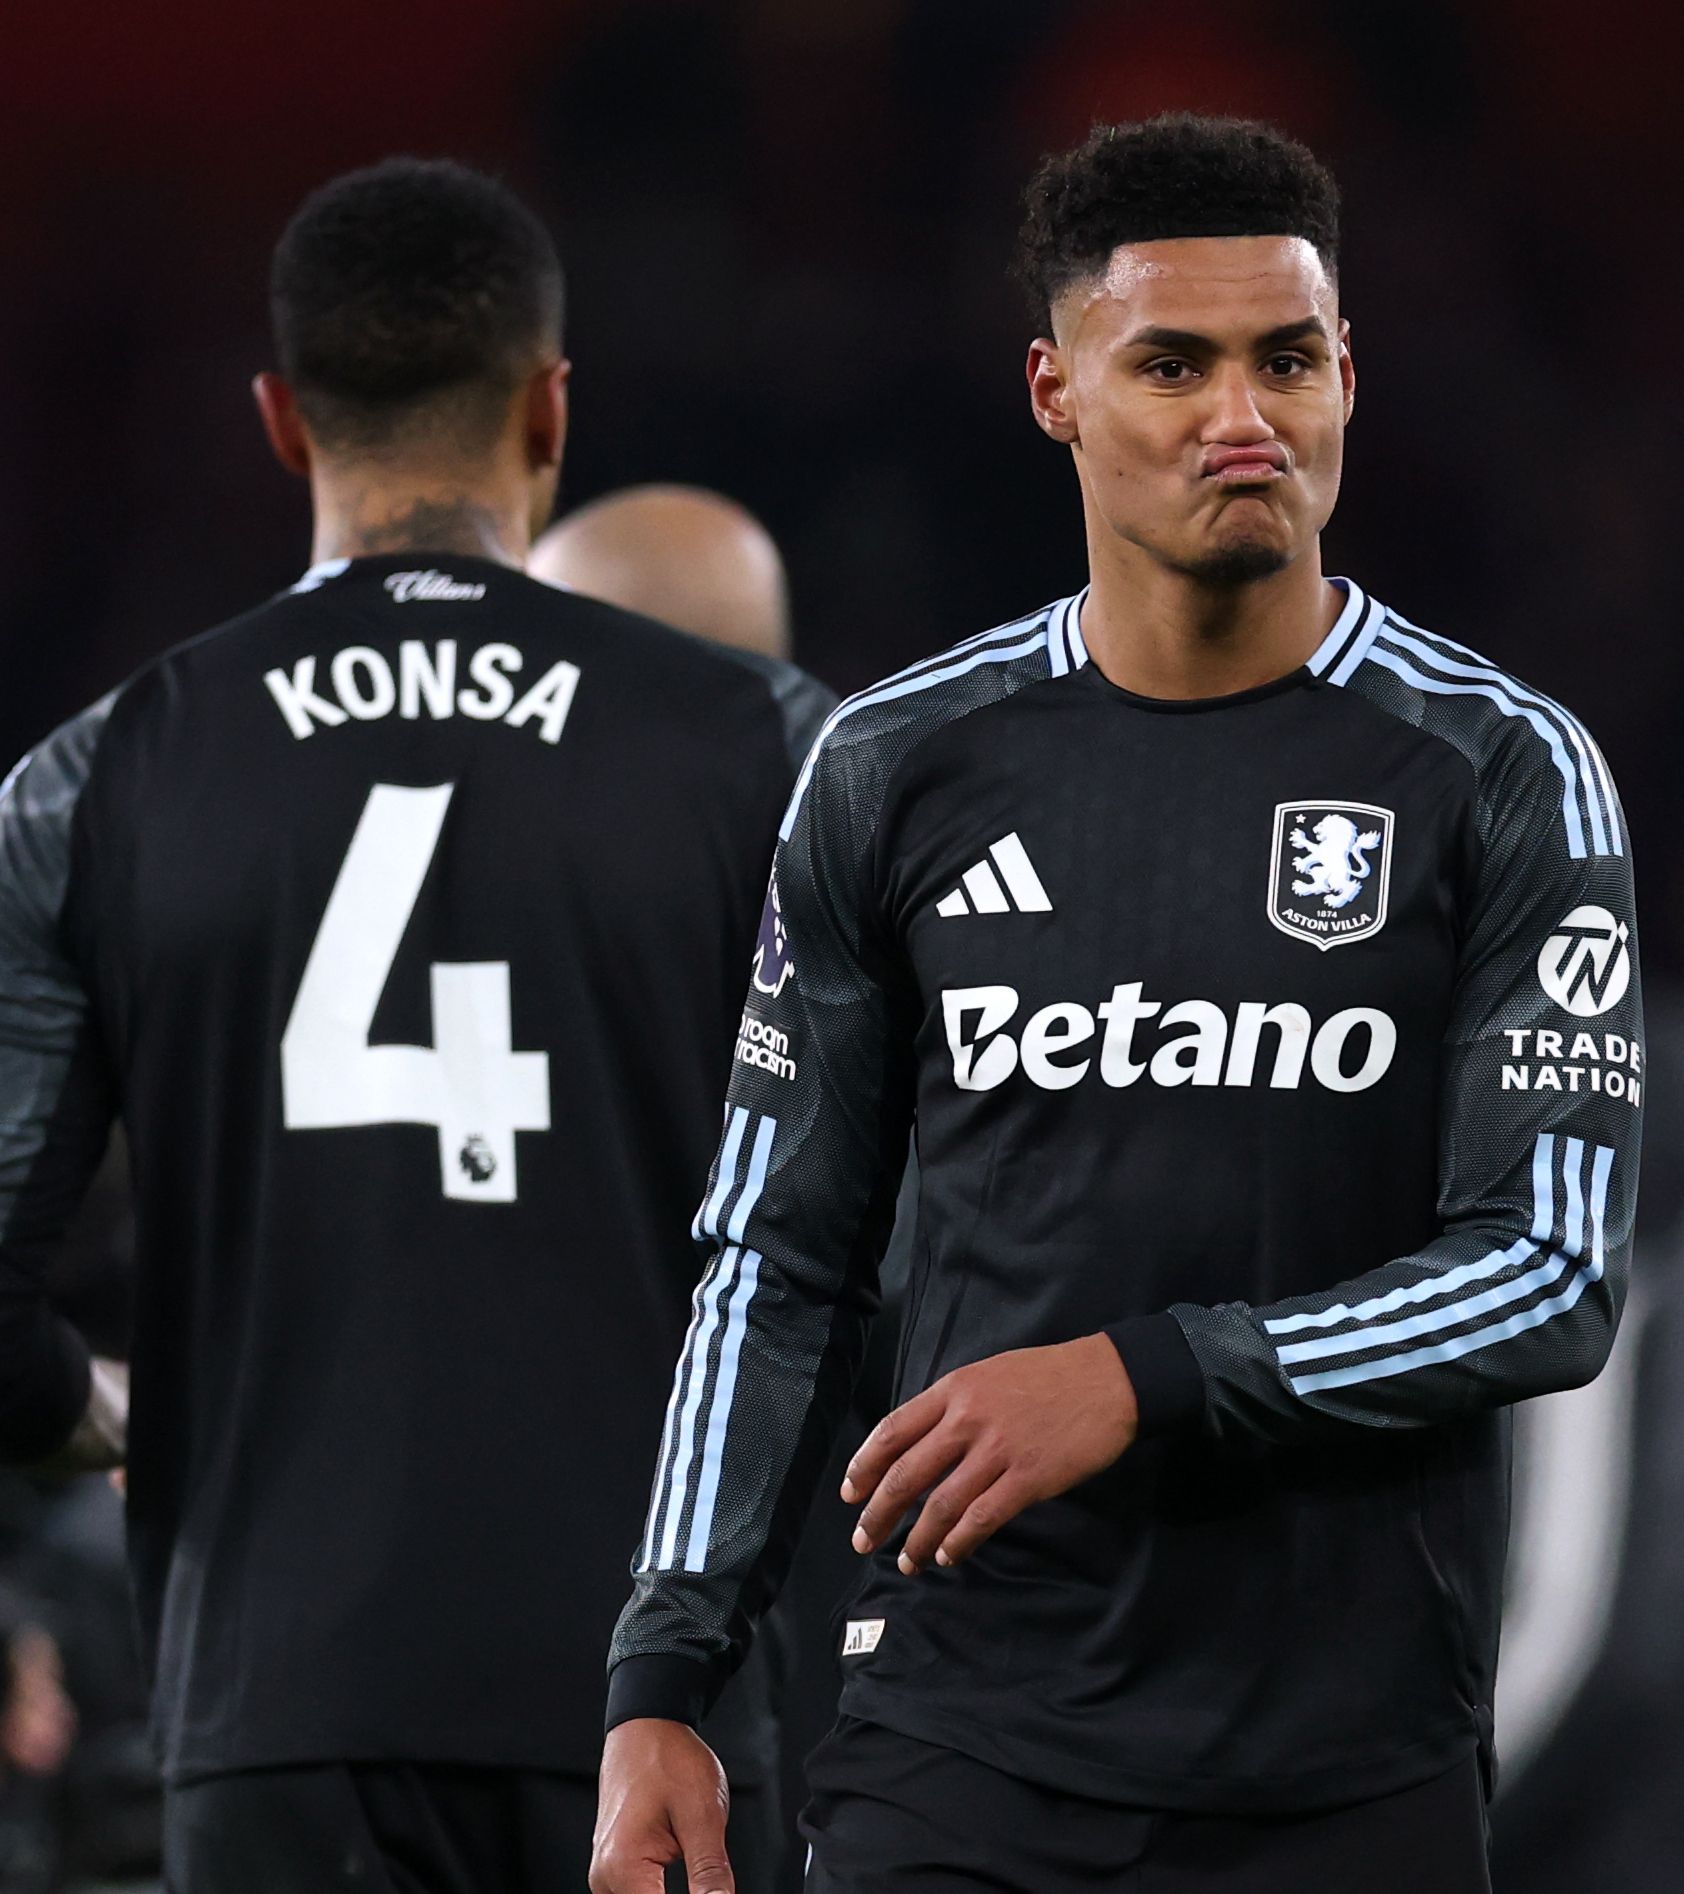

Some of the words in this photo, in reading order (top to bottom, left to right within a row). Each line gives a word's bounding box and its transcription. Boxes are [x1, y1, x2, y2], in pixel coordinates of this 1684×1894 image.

[265, 640, 580, 744] KONSA
[1281, 908, 1329, 932] ASTON
[1330, 913, 1372, 932] VILLA
[1316, 910, 1338, 919] 1874
[281, 783, 550, 1203] 4
[941, 981, 1397, 1093] Betano
[1504, 1029, 1641, 1073] TRADE
[1501, 1065, 1640, 1108] NATION
